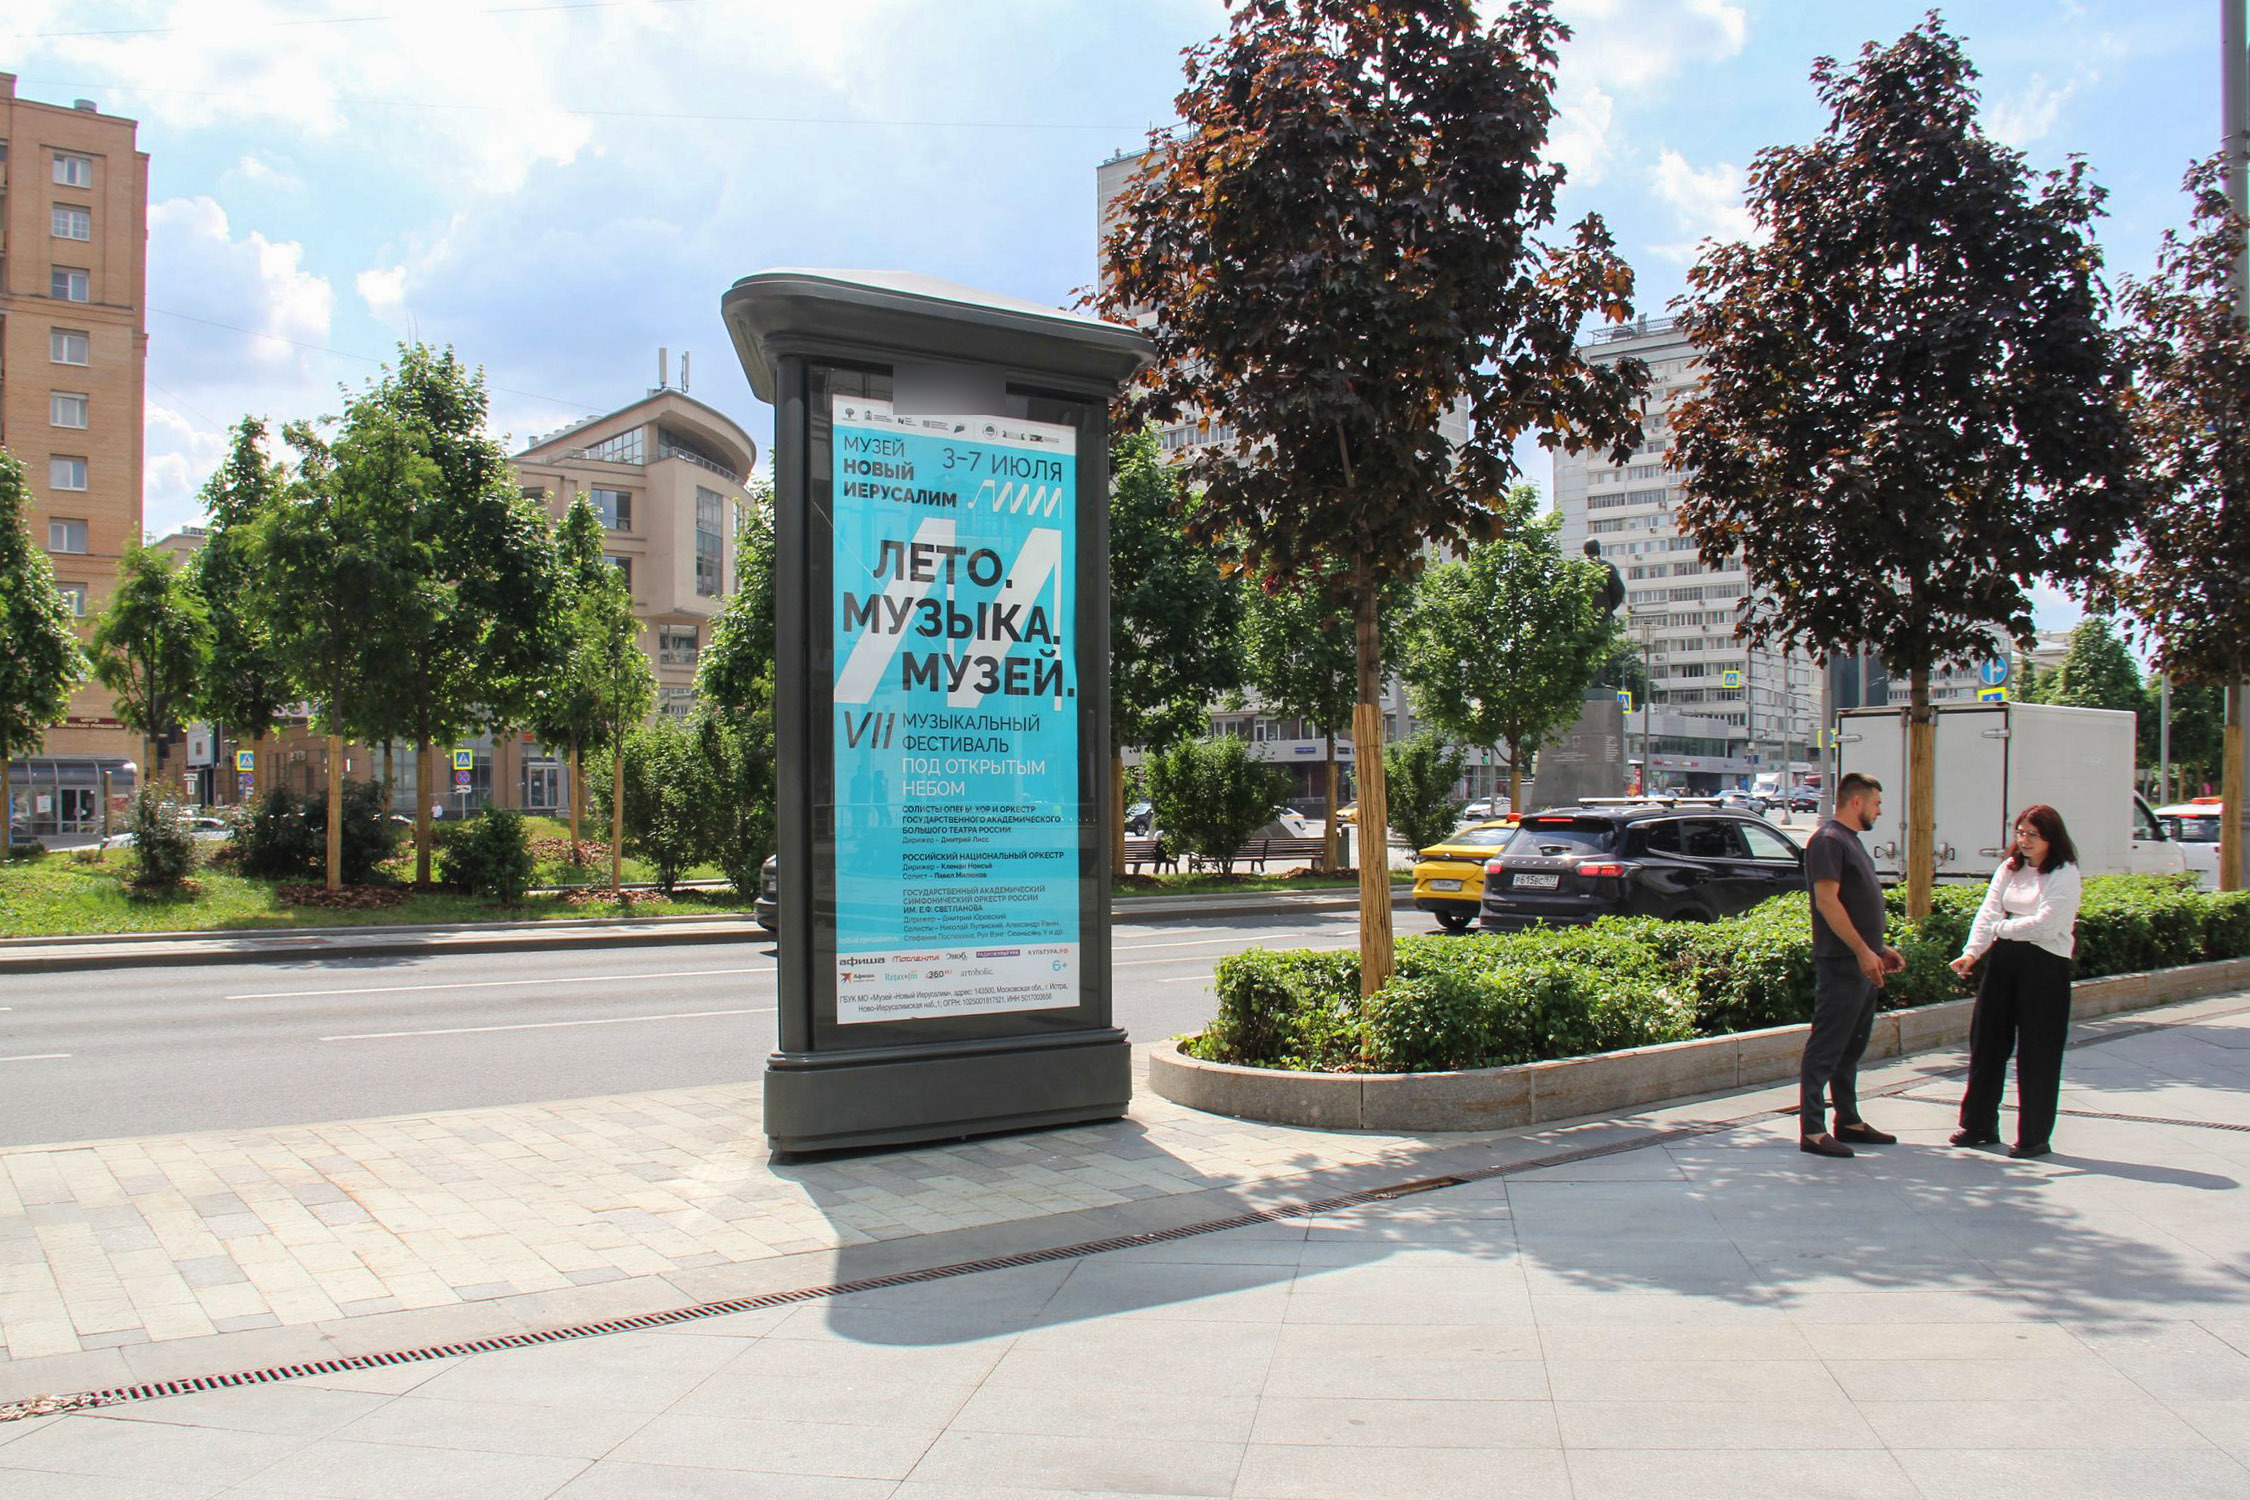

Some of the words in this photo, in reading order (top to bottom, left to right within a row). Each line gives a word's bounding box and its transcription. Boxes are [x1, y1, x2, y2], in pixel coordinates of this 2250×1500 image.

[843, 436, 905, 458] МУЗЕЙ
[843, 457, 914, 481] НОВЫЙ
[992, 453, 1063, 483] ИЮЛЯ
[843, 481, 958, 508] ИЕРУСАЛИМ
[873, 539, 1013, 589] ЛЕТО.
[843, 591, 1061, 645] МУЗЫКА.
[902, 648, 1076, 698] МУЗЕЙ.
[844, 710, 896, 750] VII
[902, 712, 1041, 733] МУЗЫКАЛЬНЫЙ
[902, 735, 1010, 753] ФЕСТИВАЛЬ
[902, 758, 941, 777] ПОД
[945, 758, 1046, 776] ОТКРЫТЫМ
[902, 780, 965, 797] НЕБОМ
[902, 805, 943, 813] СОЛИСТЫ
[975, 805, 991, 813] ХОР
[992, 805, 999, 813] И
[1000, 805, 1037, 813] ОРКЕСТР
[902, 815, 986, 825] ГОСУДАРСТВЕННОГО
[987, 815, 1061, 825] АКАДЕМИЧЕСКОГО
[902, 826, 948, 835] БОЛЬШОГО
[949, 826, 978, 834] ТЕАТРА
[978, 825, 1012, 834] РОССИИ
[941, 836, 971, 844] Дмитрий
[902, 852, 958, 862] РОССИЙСКИЙ
[959, 851, 1028, 861] НАЦИОНАЛЬНЫЙ
[1028, 851, 1065, 860] ОРКЕСТР
[902, 887, 978, 897] ГОСУДАРСТВЕННЫЙ
[980, 885, 1046, 894] АКАДЕМИЧЕСКИЙ
[902, 895, 973, 905] СИМФОНИЧЕСКИЙ
[973, 894, 1007, 903] ОРКЕСТР
[1007, 894, 1039, 902] РОССИИ
[934, 904, 983, 913] СВЕТЛАНОВА
[839, 956, 886, 967] афиша
[1052, 960, 1069, 973] 6+
[839, 994, 857, 1004] ГБУК
[857, 993, 869, 1002] МО
[996, 984, 1031, 993] Московская
[858, 1002, 923, 1013] Ново-Иерусалимская
[1007, 994, 1021, 1003] ИНН
